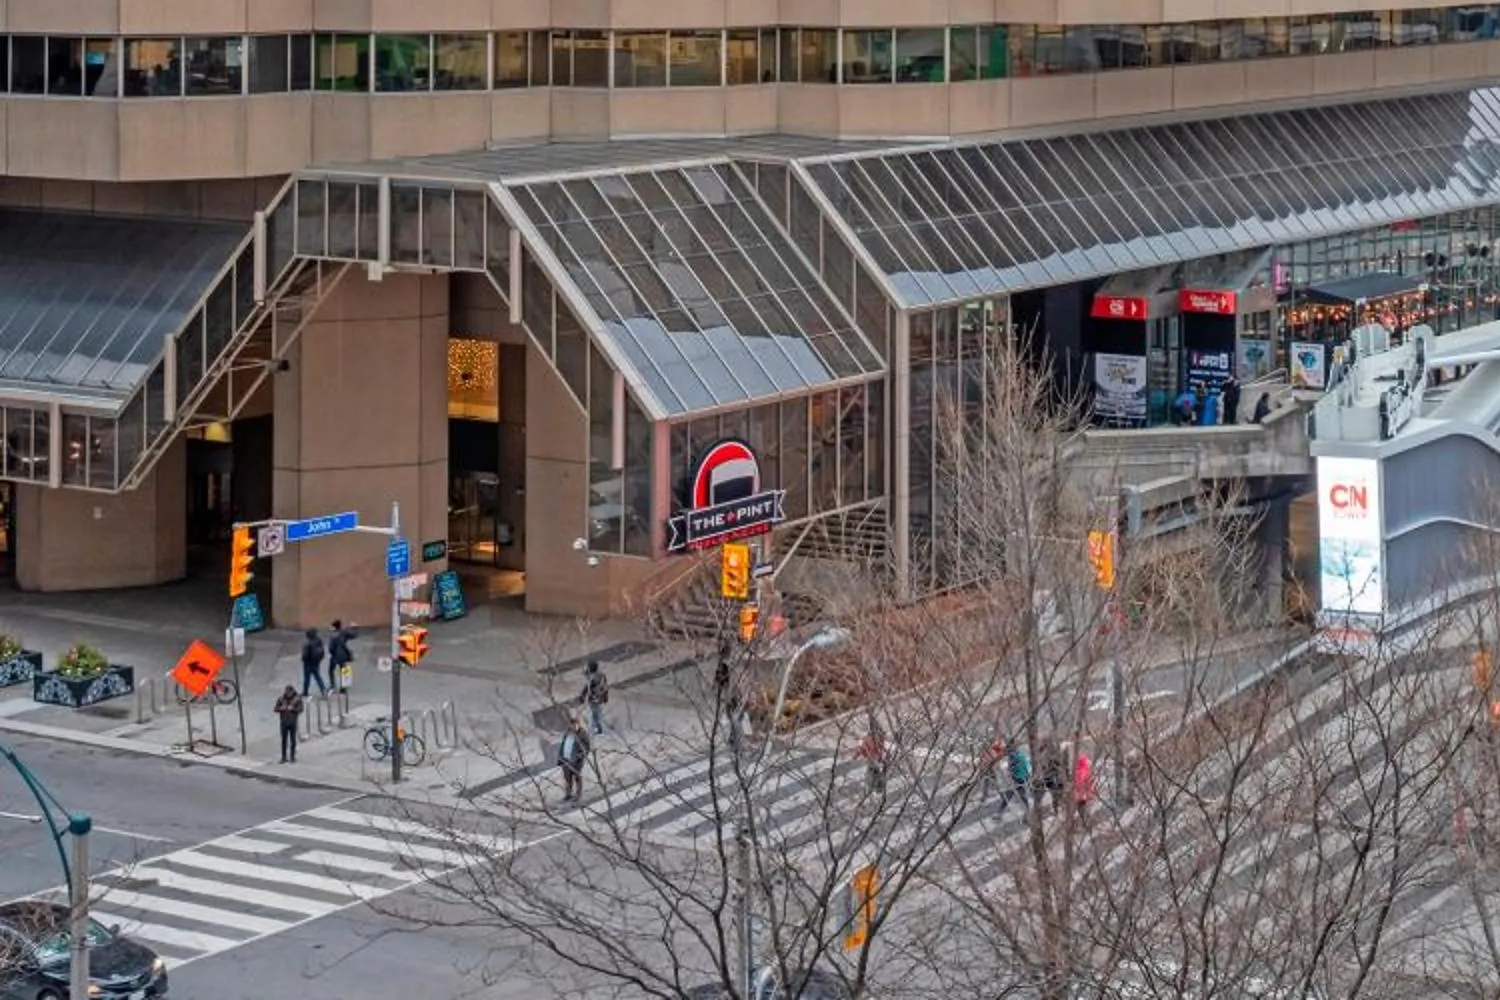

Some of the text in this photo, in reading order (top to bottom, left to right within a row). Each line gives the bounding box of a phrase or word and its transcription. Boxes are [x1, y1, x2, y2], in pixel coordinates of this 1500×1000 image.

[1330, 483, 1367, 509] CN
[307, 521, 332, 533] John
[693, 501, 772, 530] THE PINT
